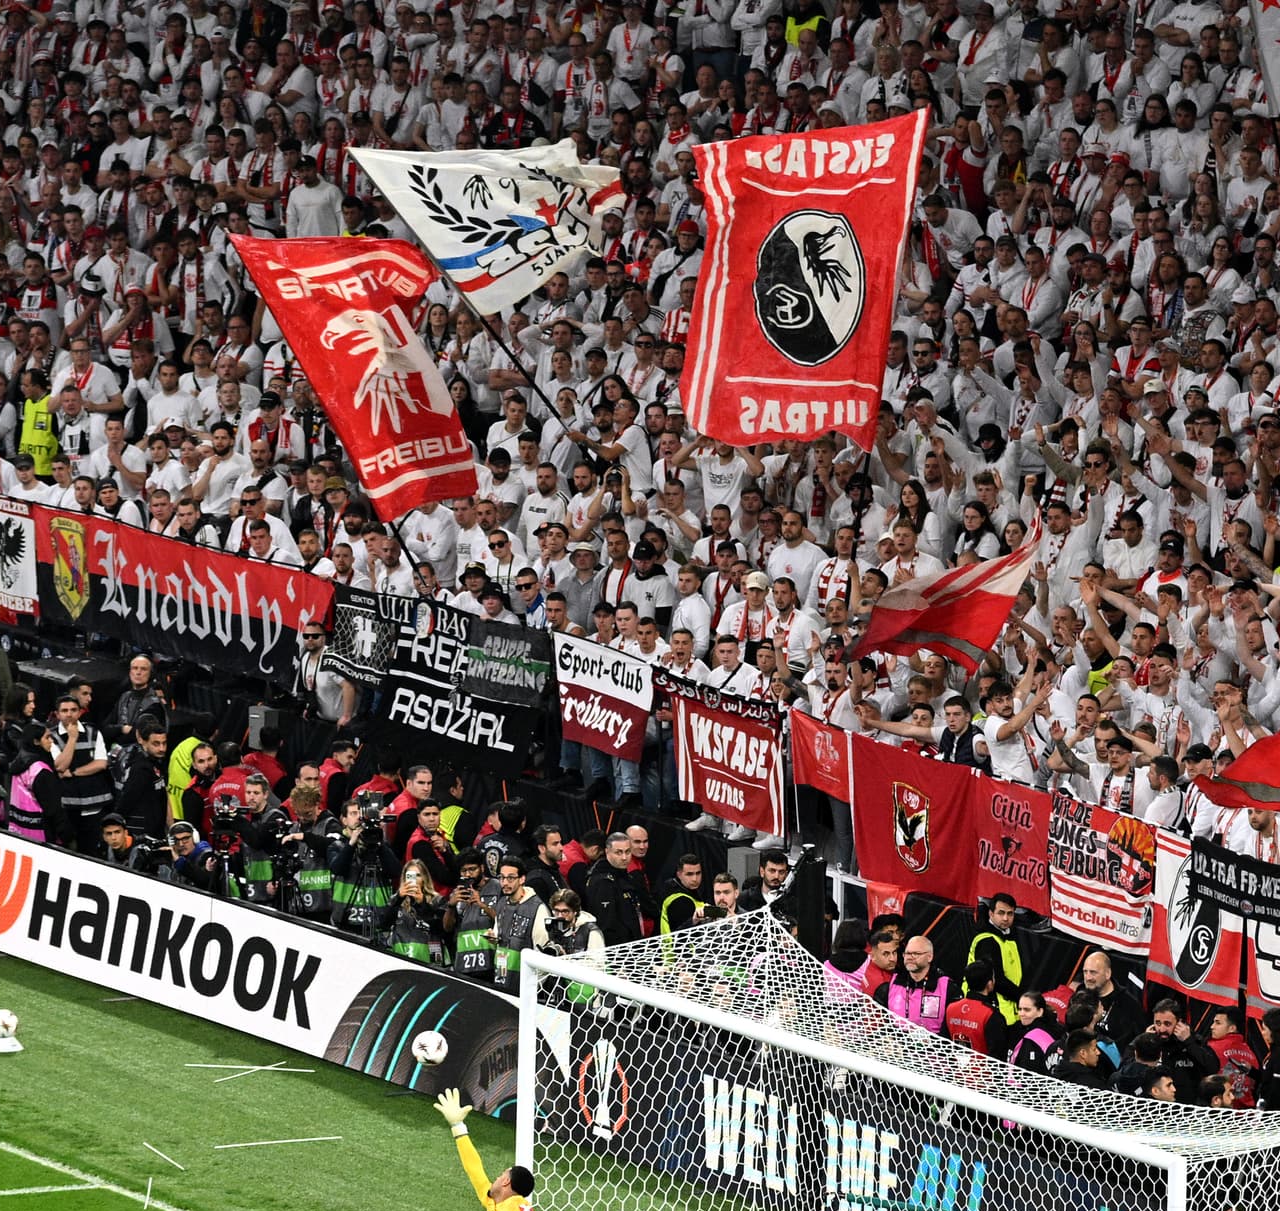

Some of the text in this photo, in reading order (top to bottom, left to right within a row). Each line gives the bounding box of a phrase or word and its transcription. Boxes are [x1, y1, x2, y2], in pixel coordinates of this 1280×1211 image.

[558, 643, 643, 694] Sport-Club
[706, 778, 745, 811] ULTRAS
[991, 792, 1033, 830] Città
[1052, 794, 1092, 828] WILDE
[462, 934, 481, 948] TV
[463, 952, 485, 969] 278
